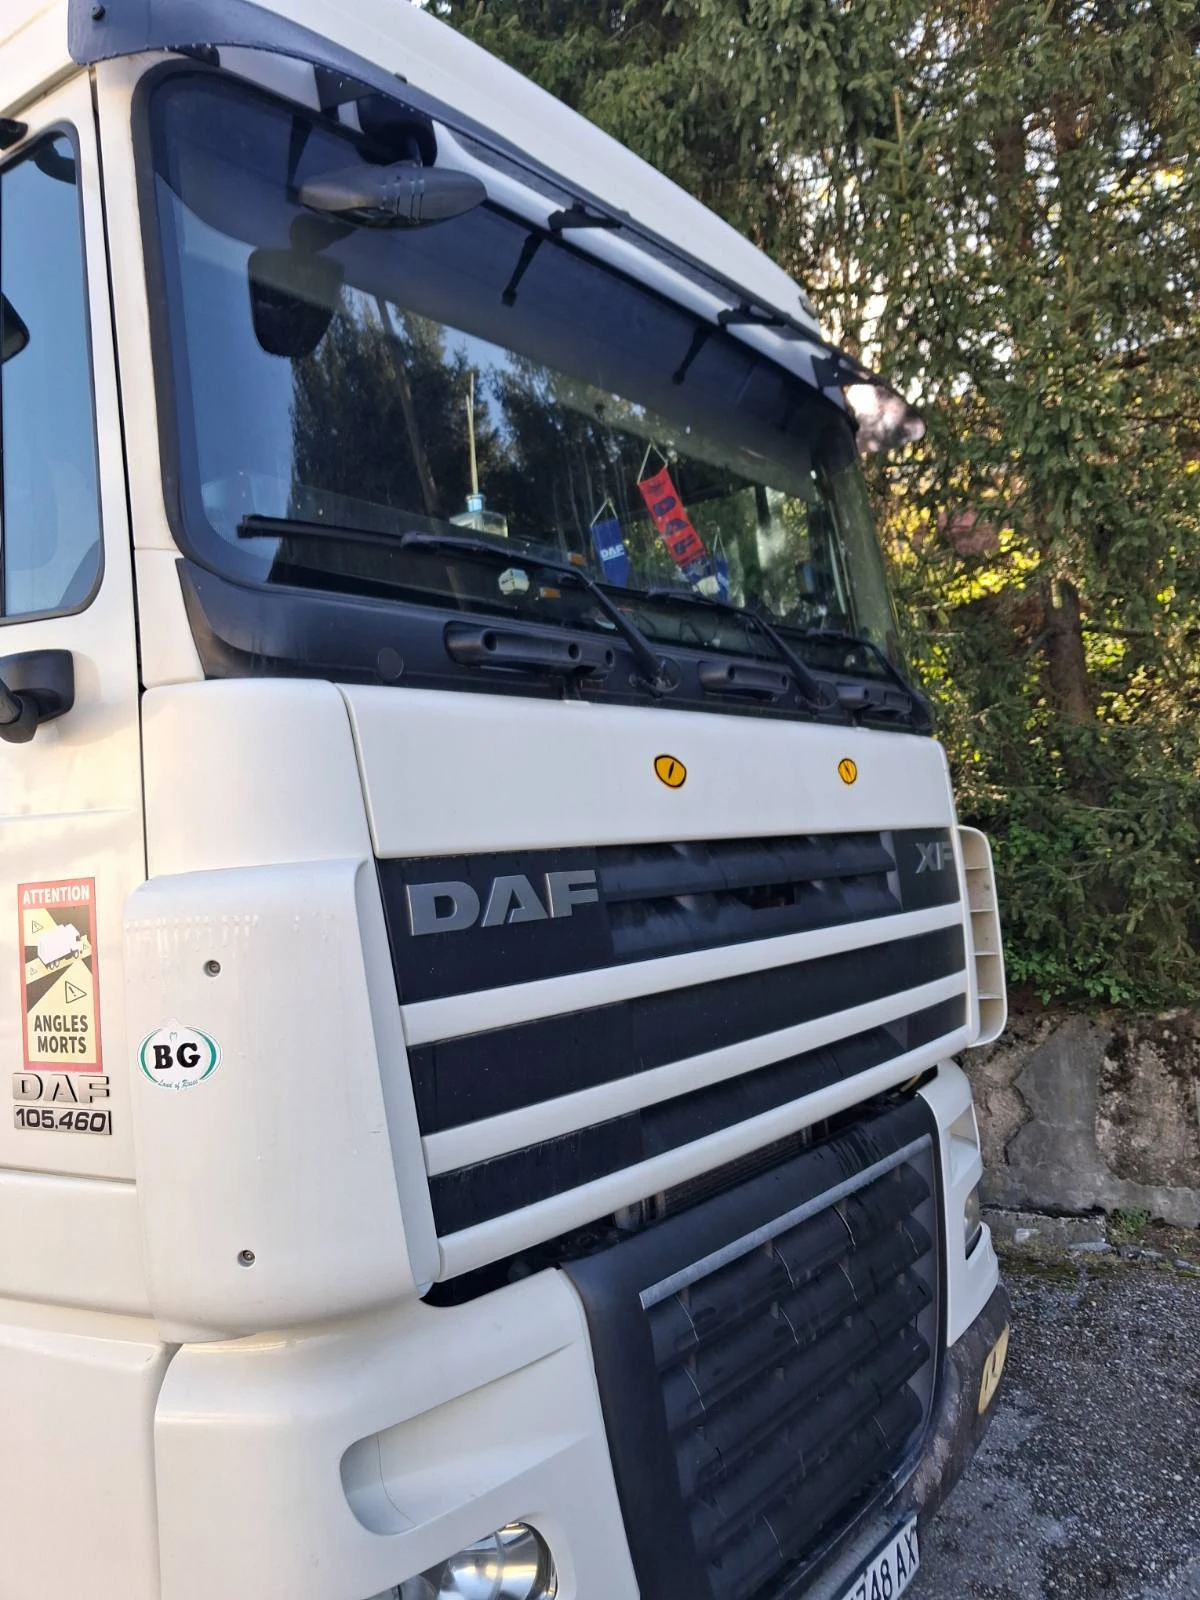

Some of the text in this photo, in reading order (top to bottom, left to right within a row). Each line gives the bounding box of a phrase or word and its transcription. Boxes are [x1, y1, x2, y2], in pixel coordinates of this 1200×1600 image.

[600, 544, 625, 561] DAF
[915, 841, 953, 874] XF
[23, 885, 90, 904] ATTENTION
[406, 870, 599, 936] DAF
[34, 1015, 88, 1032] ANGLES
[37, 1036, 87, 1054] MORTS
[153, 1042, 201, 1069] BG
[12, 1072, 110, 1103] DAF
[16, 1108, 106, 1132] 105.460
[851, 1527, 916, 1600] 748 AX
